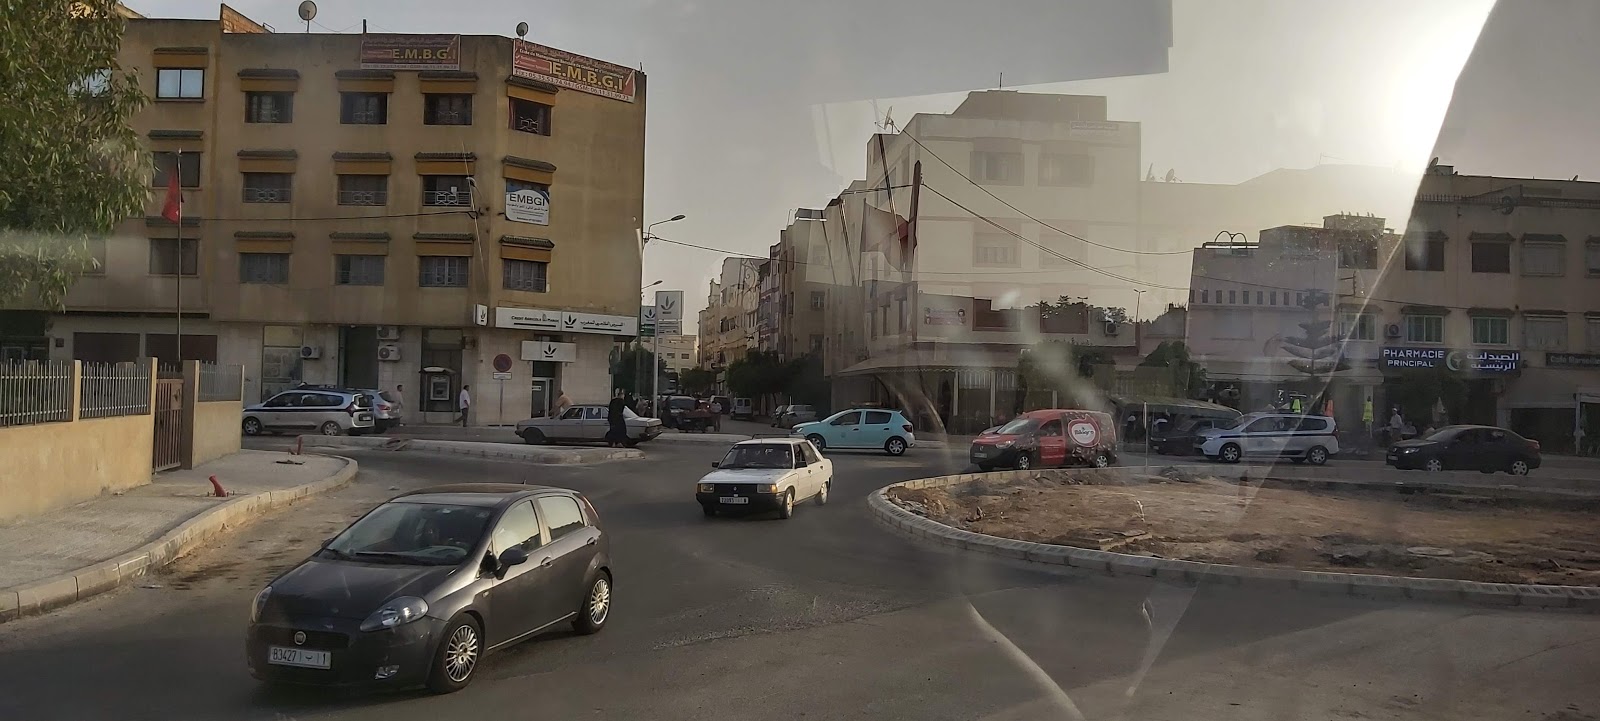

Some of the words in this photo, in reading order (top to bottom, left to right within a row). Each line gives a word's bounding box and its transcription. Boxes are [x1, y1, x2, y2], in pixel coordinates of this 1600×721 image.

[509, 193, 545, 206] EMBGI
[1383, 349, 1445, 359] PHARMACIE
[1387, 359, 1434, 368] PRINCIPAL
[272, 648, 297, 662] 83427
